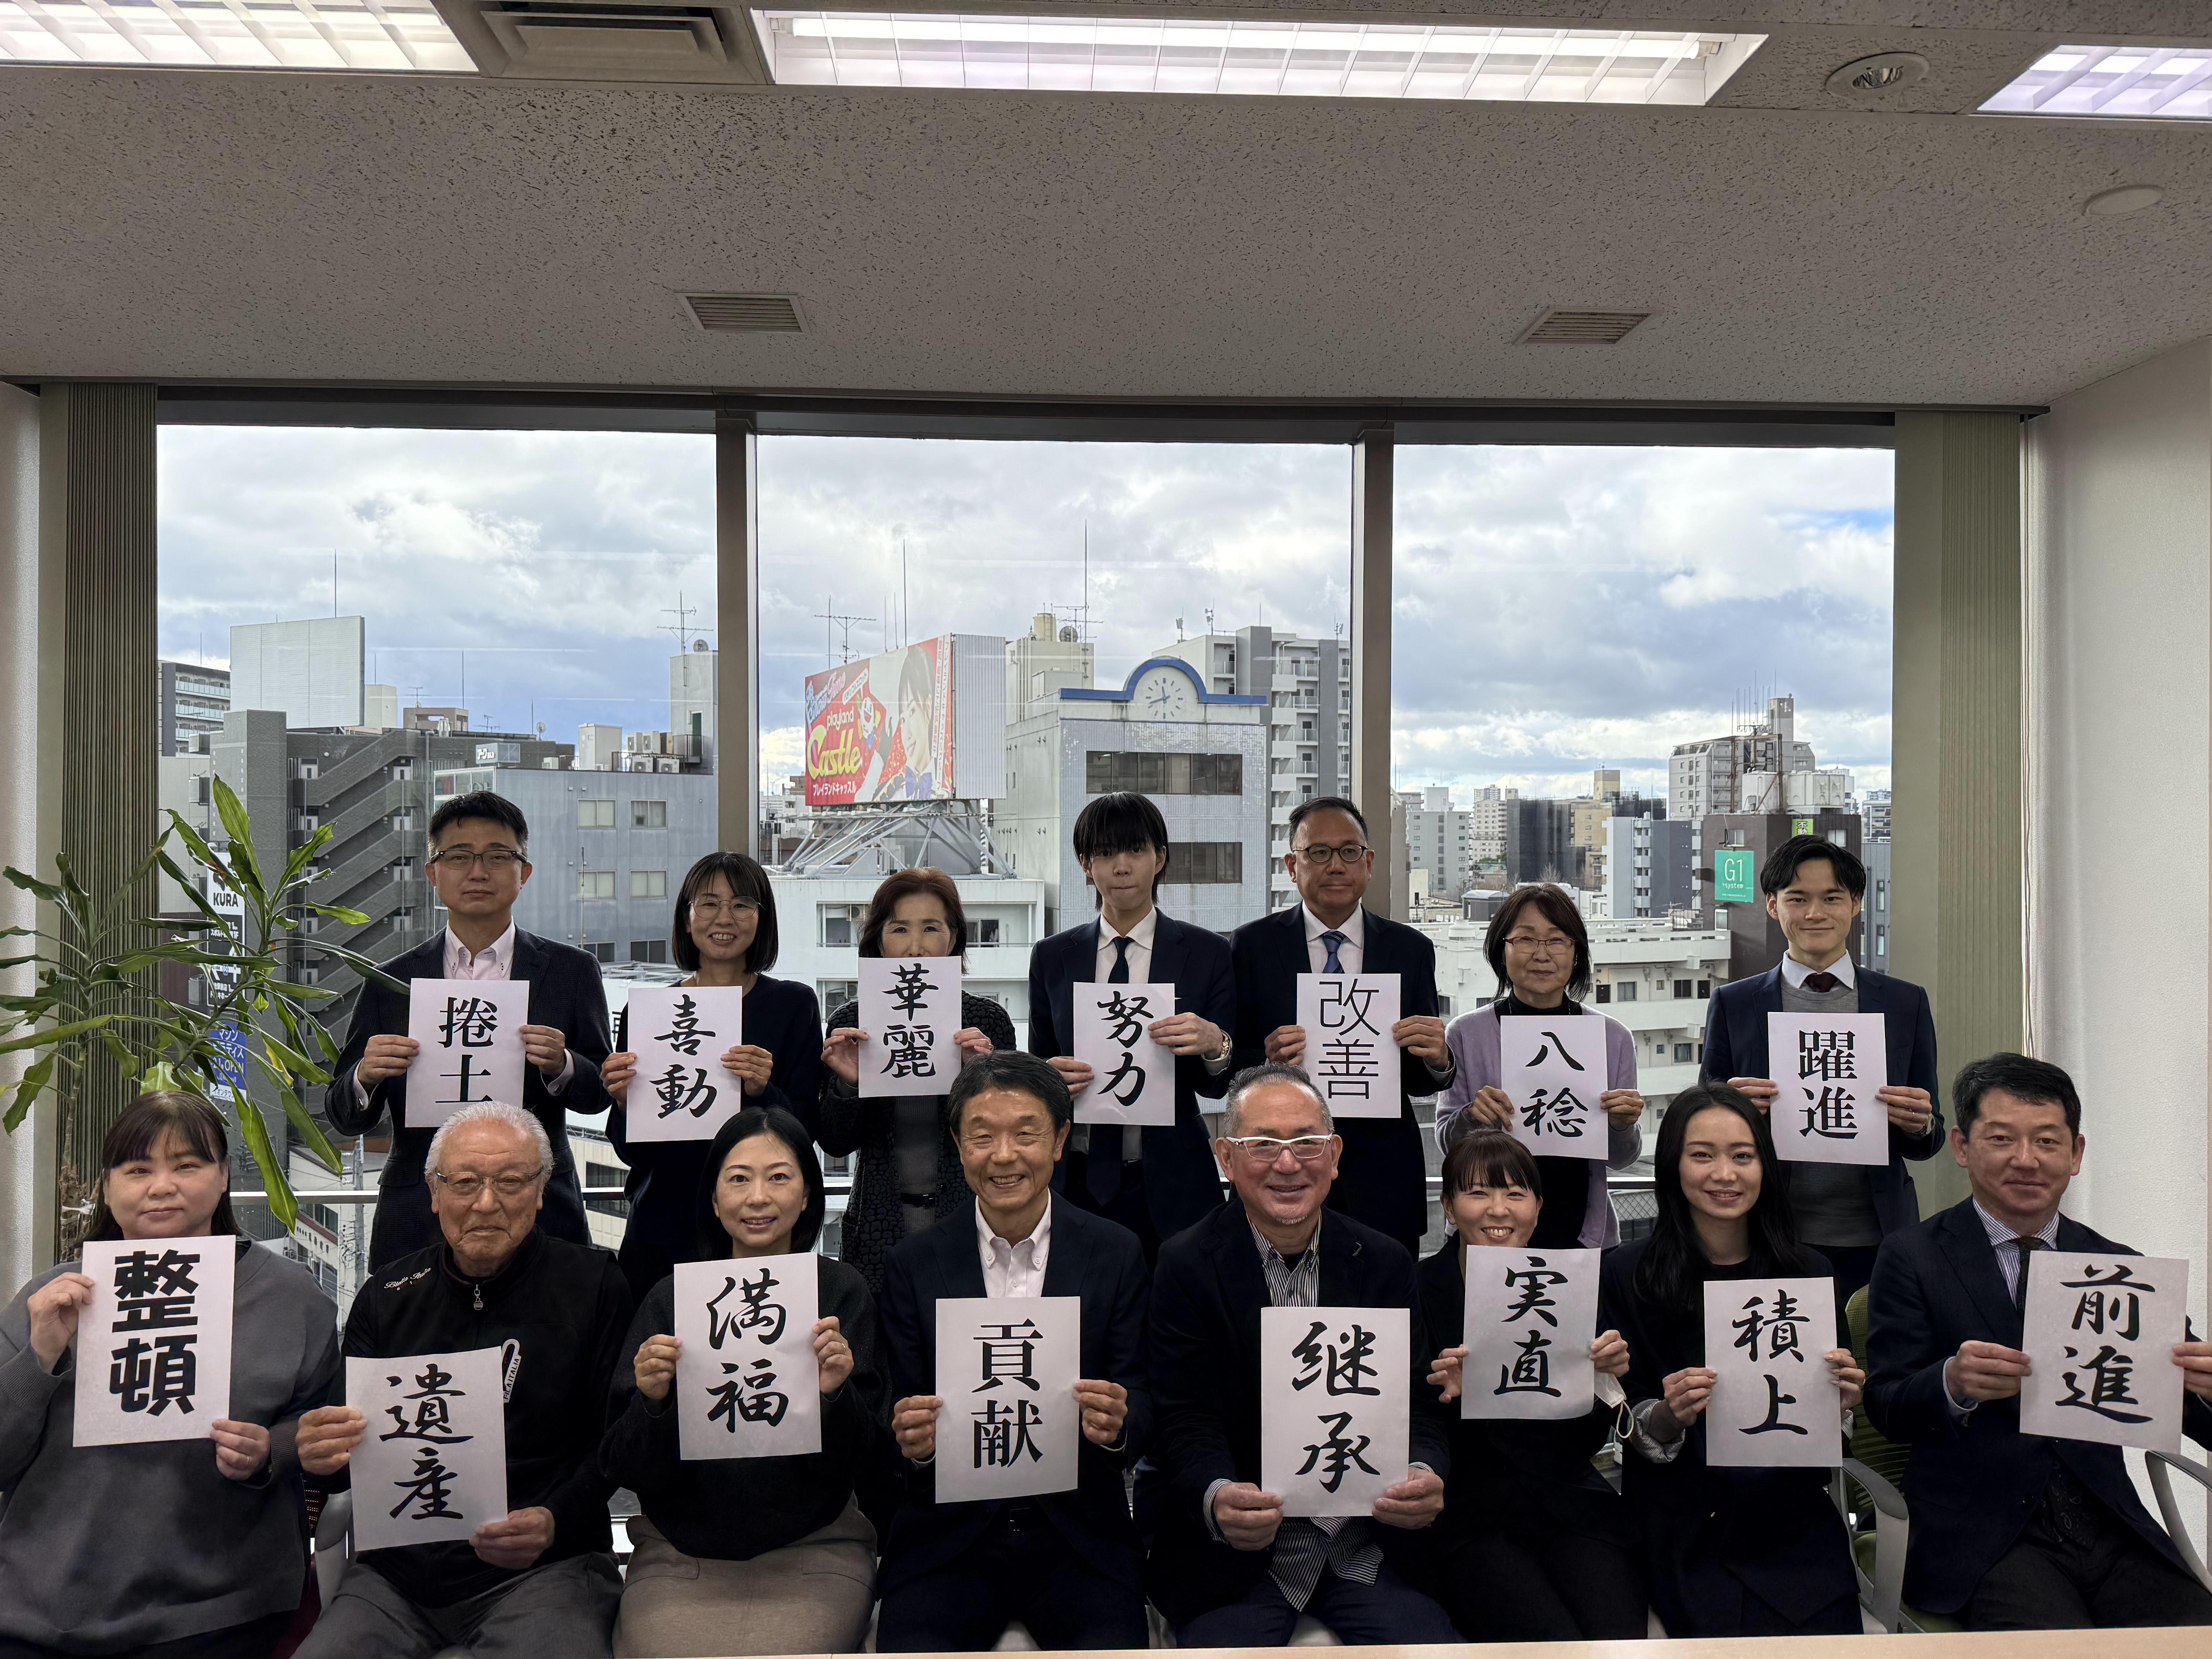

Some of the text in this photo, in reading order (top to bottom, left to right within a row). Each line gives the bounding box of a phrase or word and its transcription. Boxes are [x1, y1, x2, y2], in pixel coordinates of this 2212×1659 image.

[807, 725, 863, 780] Castle
[827, 706, 854, 731] playland
[813, 781, 857, 797] プレイランドキャッスル
[213, 893, 239, 907] KURA
[1725, 858, 1742, 881] G1
[435, 997, 498, 1103] 捲土
[649, 994, 717, 1119] 喜動
[879, 963, 939, 1078] 華麗
[1096, 991, 1154, 1107] 努力
[1318, 978, 1381, 1099] 改善
[1520, 1031, 1589, 1137] 八稔
[1798, 1030, 1859, 1139] 躍進
[109, 1249, 200, 1417] 整頓
[705, 1268, 789, 1434] 満福
[1493, 1256, 1568, 1398] 実直
[1732, 1289, 1810, 1435] 積上
[2055, 1264, 2155, 1424] 前進
[379, 1364, 474, 1520] 遺産
[971, 1318, 1043, 1469] 貢献
[1291, 1321, 1381, 1494] 継承
